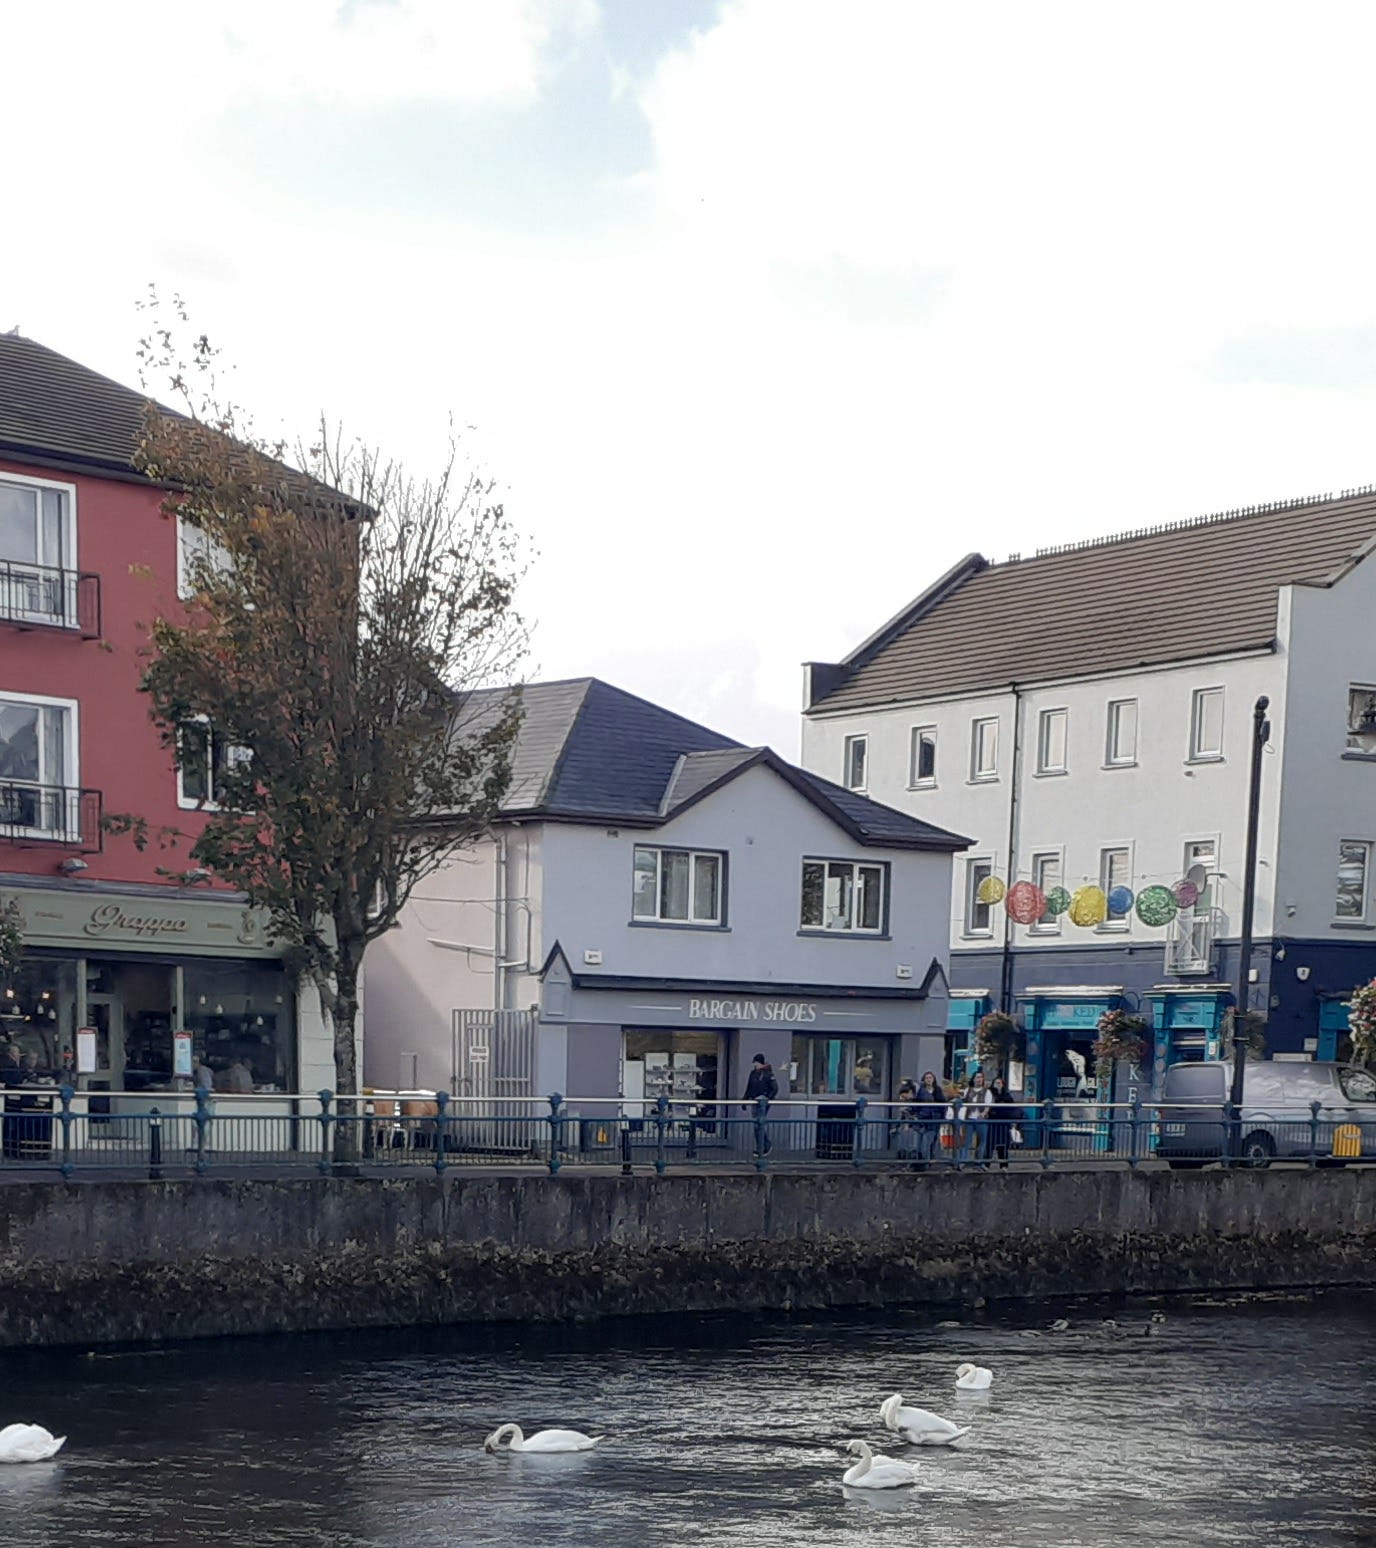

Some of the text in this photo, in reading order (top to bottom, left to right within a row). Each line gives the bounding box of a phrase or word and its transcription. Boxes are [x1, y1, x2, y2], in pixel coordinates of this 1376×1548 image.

[83, 904, 188, 936] Grappa
[689, 999, 817, 1022] BARGAIN SHOES
